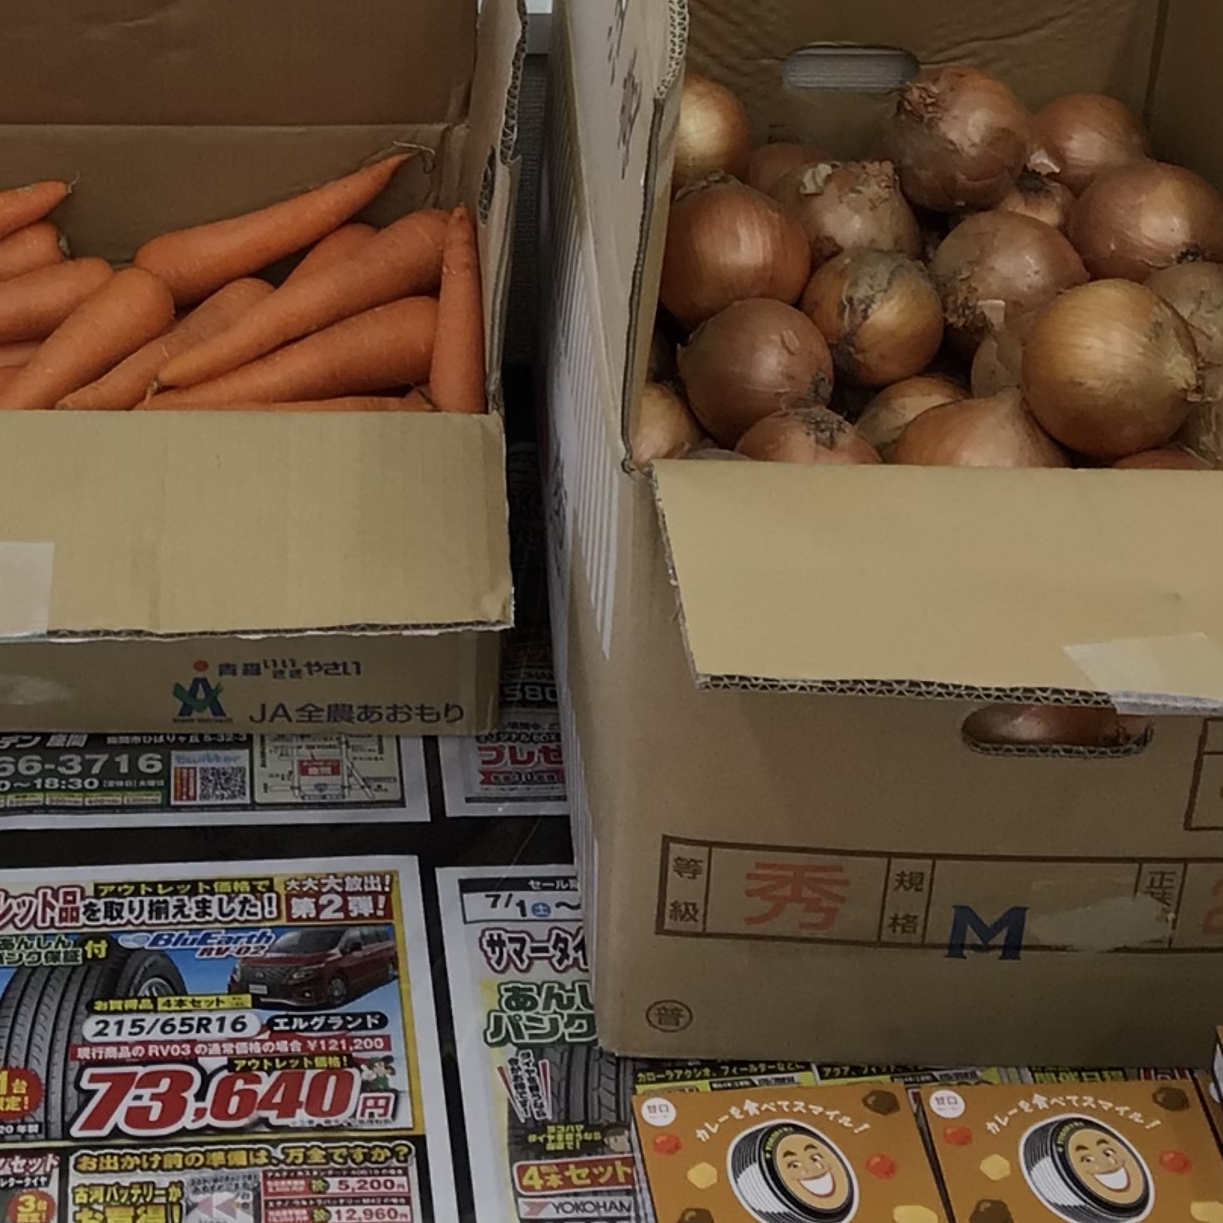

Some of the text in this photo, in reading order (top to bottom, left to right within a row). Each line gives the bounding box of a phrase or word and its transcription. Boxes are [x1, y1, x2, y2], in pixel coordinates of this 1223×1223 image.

[249, 703, 465, 724] JA全農あおもり
[98, 880, 269, 895] アウトレット価格で
[744, 861, 851, 931] 秀
[291, 894, 386, 921] 第2弾!
[145, 929, 273, 949] BluEarth
[944, 905, 1029, 960] M
[84, 939, 108, 959] 付
[196, 944, 265, 958] RV-02
[94, 1015, 248, 1038] 215/65R16
[273, 1014, 381, 1030] エルグランド
[695, 1098, 871, 1142] カレーを食べてスマイル!
[985, 1093, 1161, 1135] カレーを食べてスマイル!
[77, 1145, 410, 1170] お出かけ前の準備は、万全ですか?
[74, 1183, 182, 1203] 古河バッテリーが
